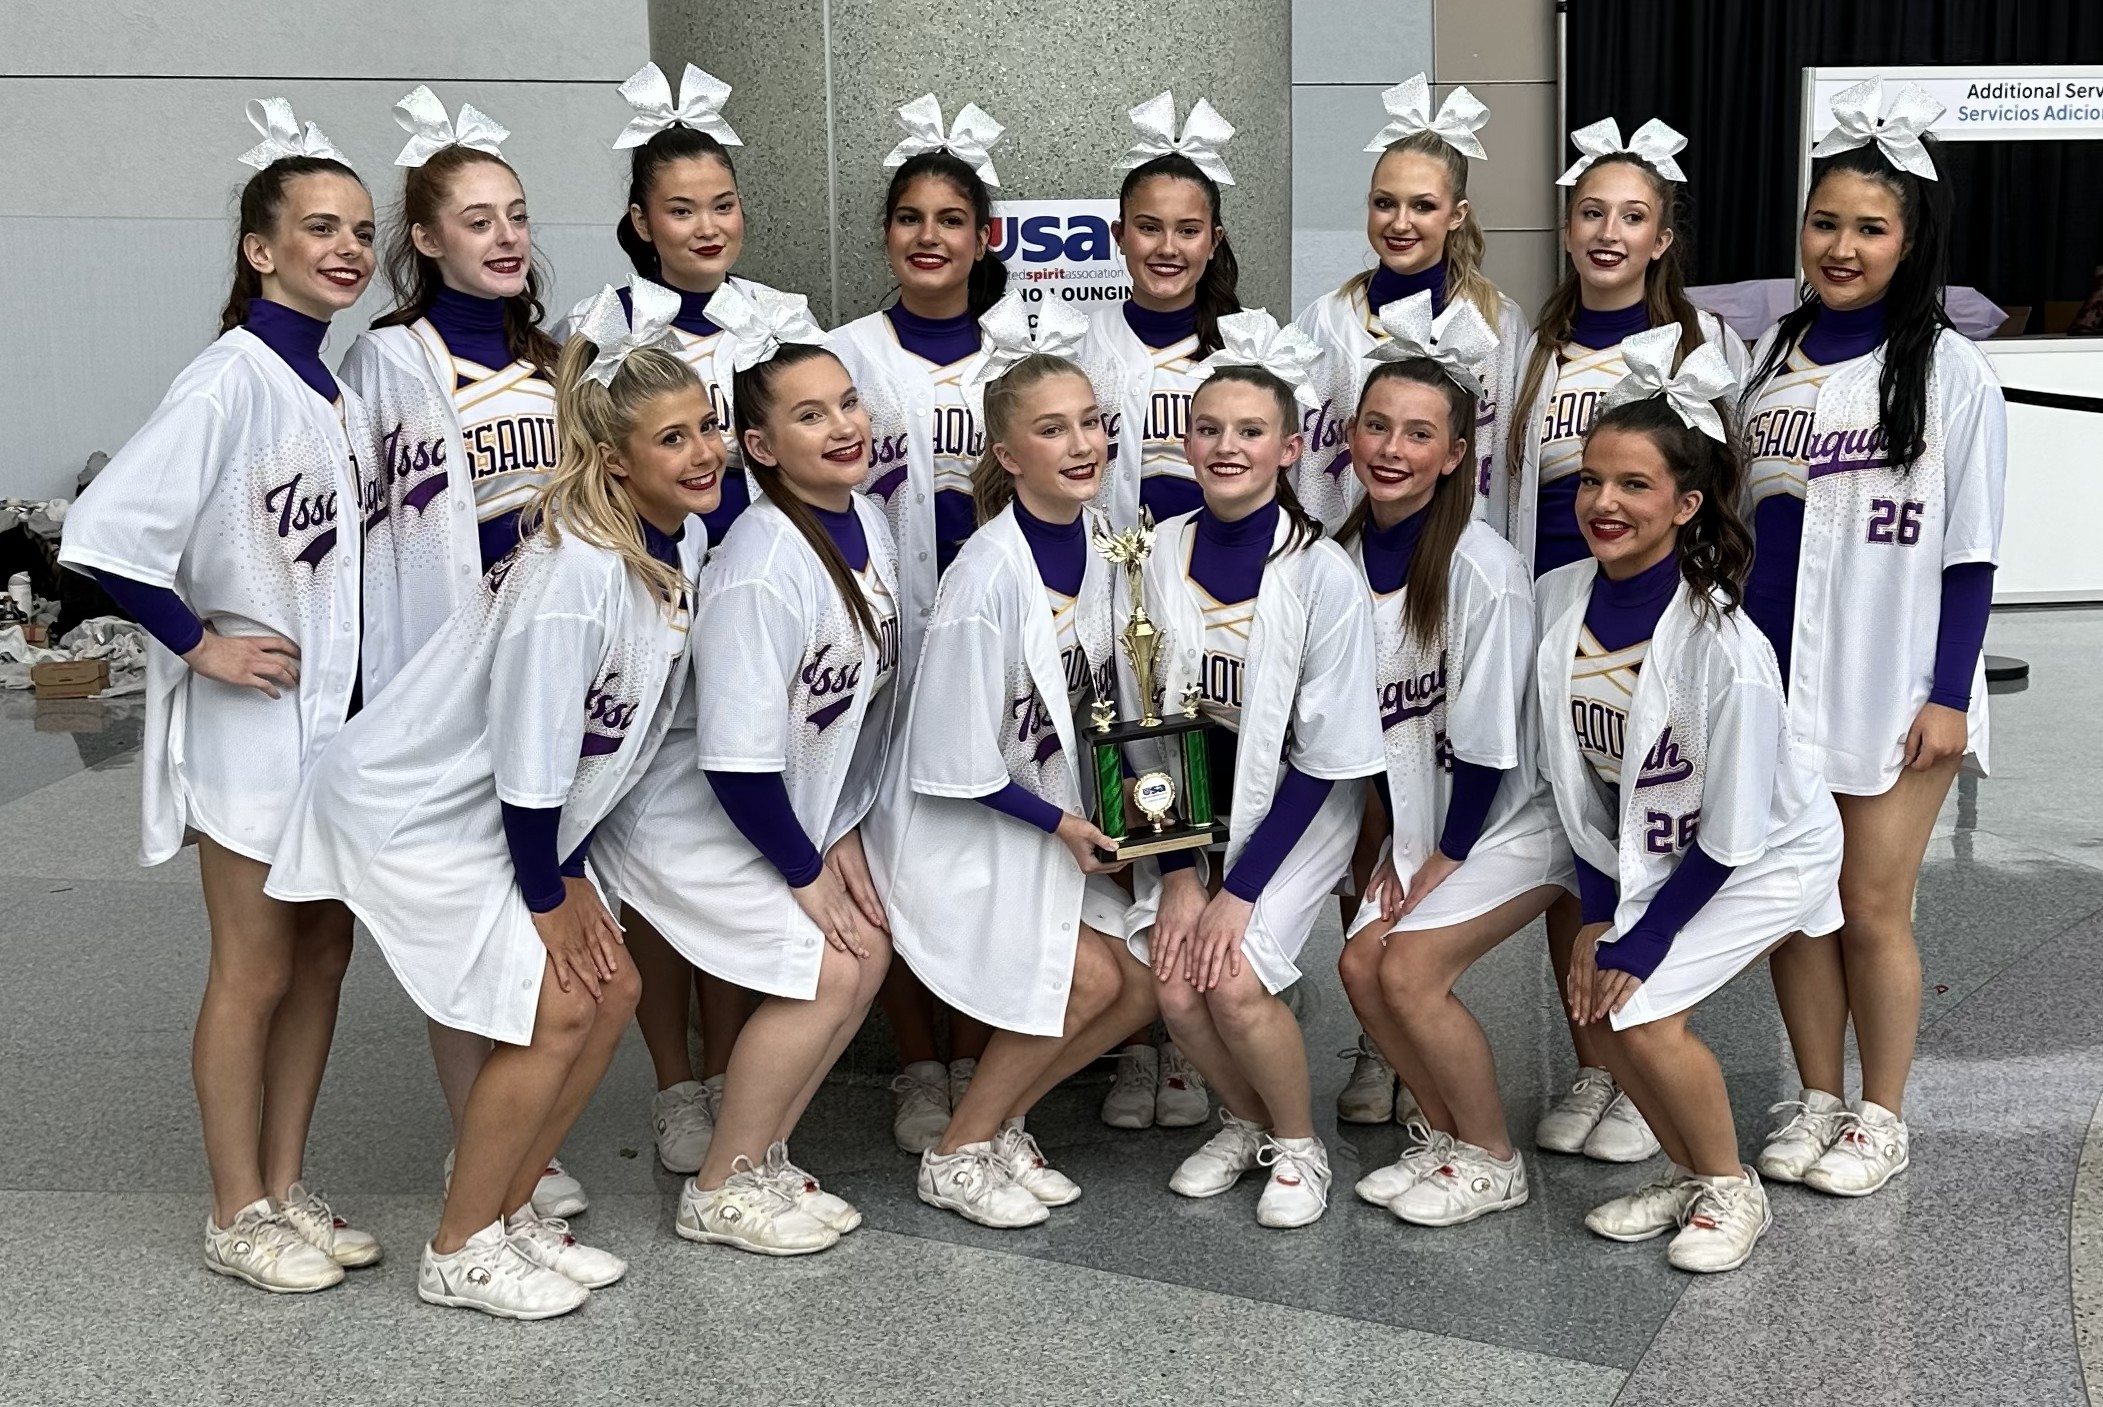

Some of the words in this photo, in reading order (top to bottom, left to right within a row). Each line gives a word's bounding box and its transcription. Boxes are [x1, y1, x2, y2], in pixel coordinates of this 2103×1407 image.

[1967, 83, 2060, 99] Additional
[1958, 104, 2040, 121] Servicios
[2043, 104, 2103, 121] Adicio
[1008, 267, 1124, 282] tedspiritassociation
[1050, 286, 1133, 302] OUNGIN
[1866, 496, 1926, 548] 26
[1644, 808, 1701, 855] 26
